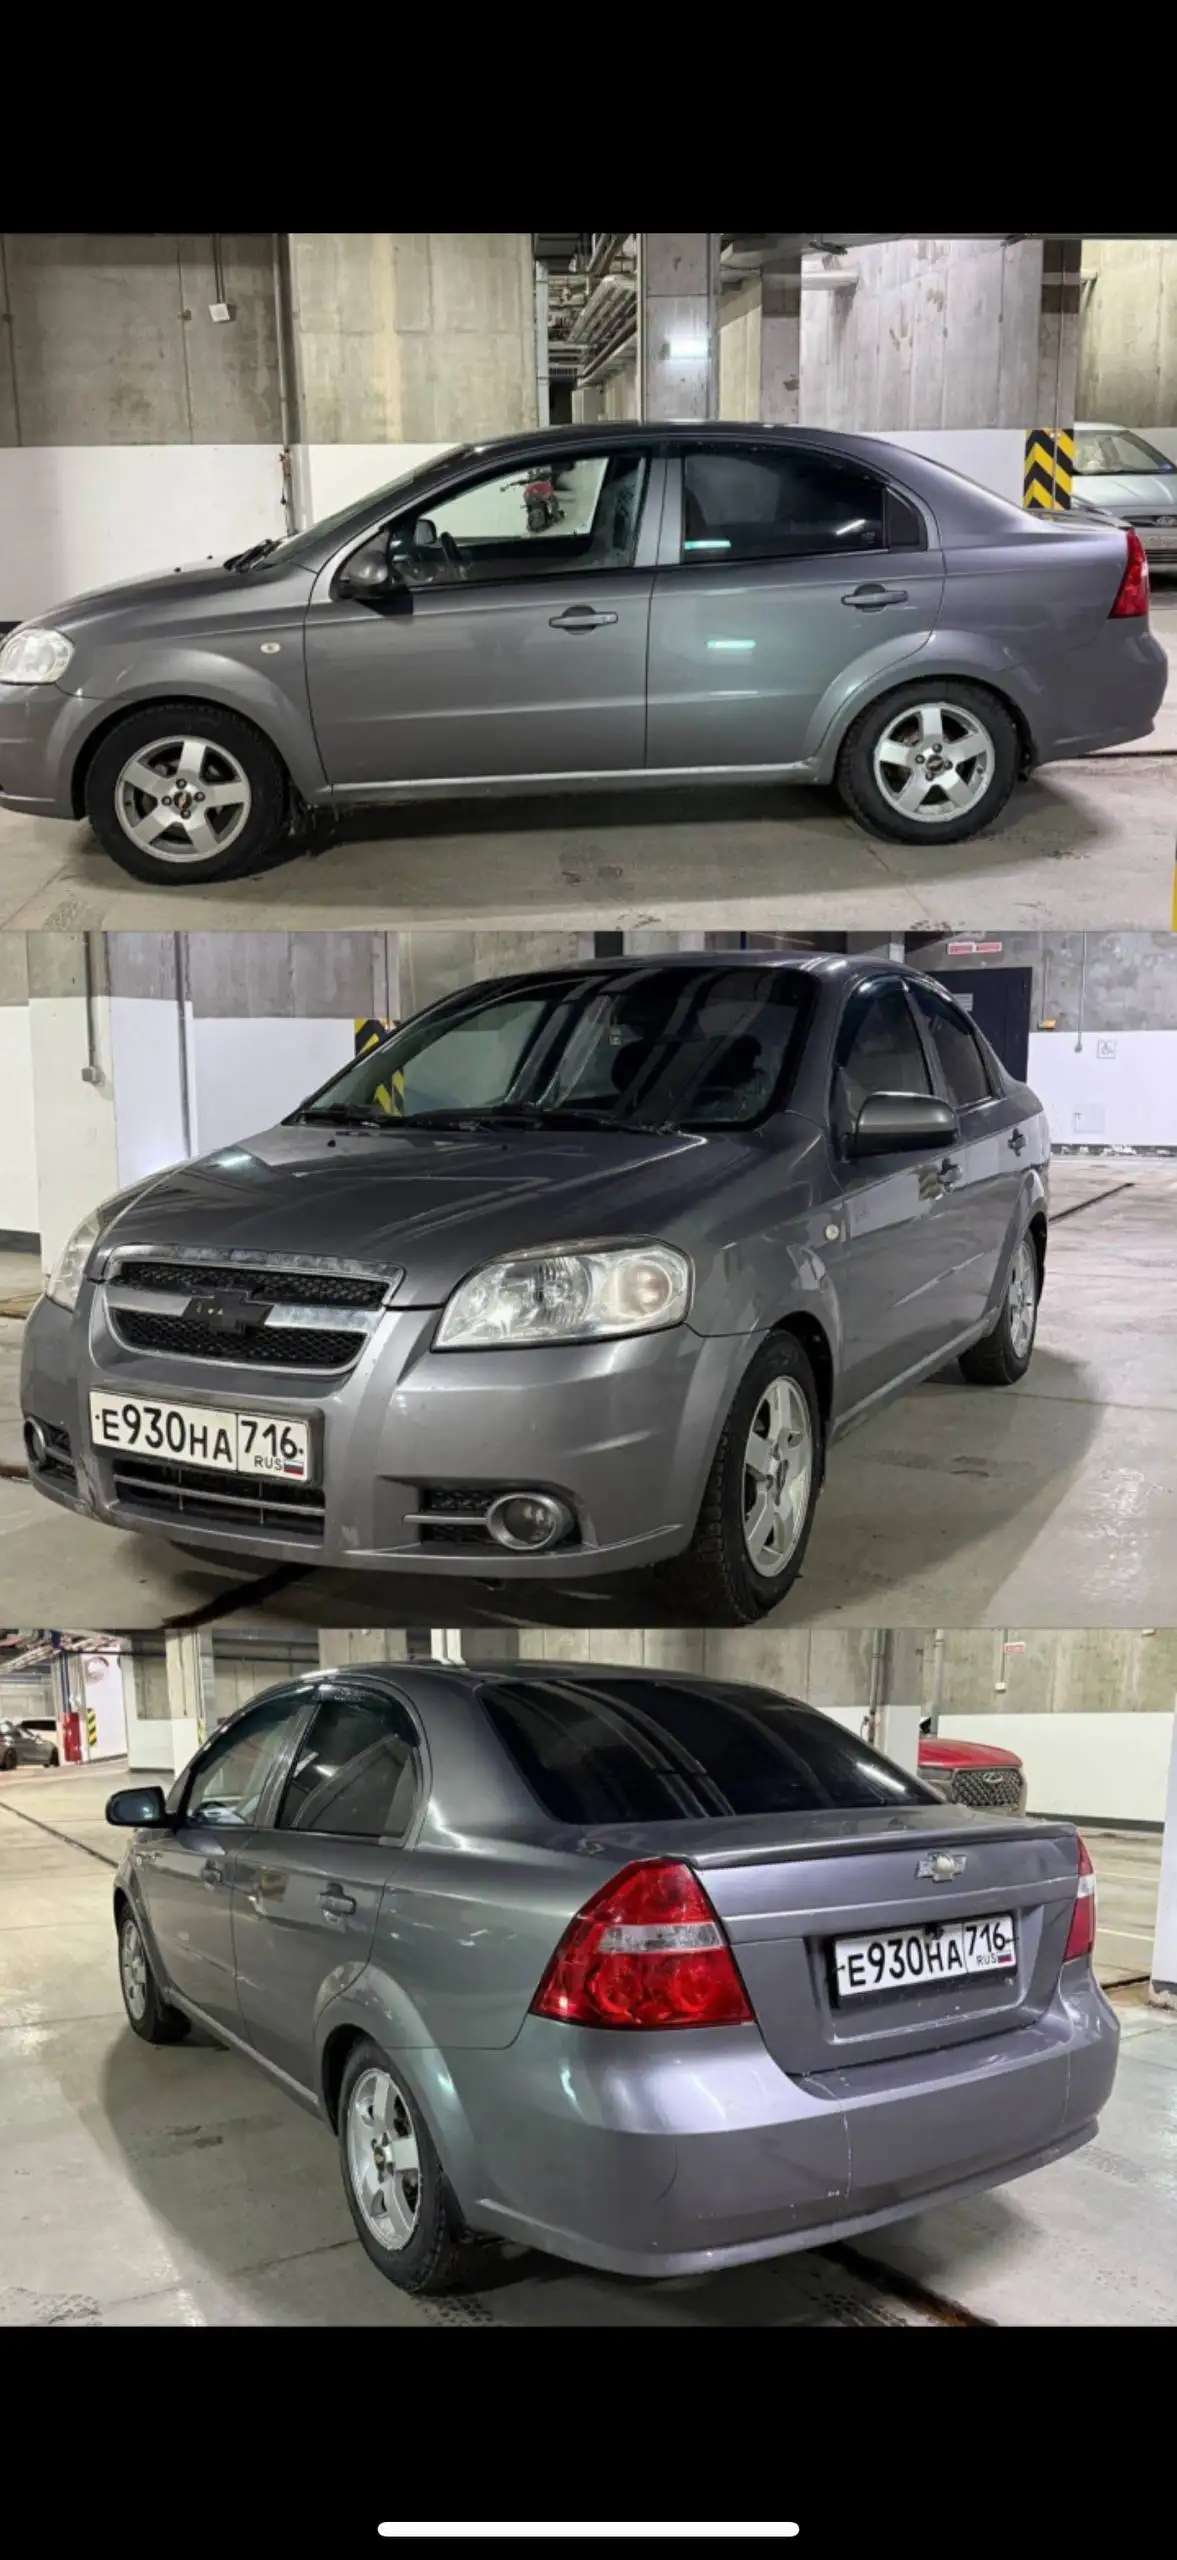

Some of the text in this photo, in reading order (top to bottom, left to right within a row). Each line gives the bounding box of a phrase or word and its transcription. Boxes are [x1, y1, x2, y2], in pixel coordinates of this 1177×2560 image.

[241, 1420, 298, 1459] 716
[254, 1455, 283, 1471] RUS
[966, 1922, 1006, 1956] 716
[976, 1952, 997, 1966] RUS
